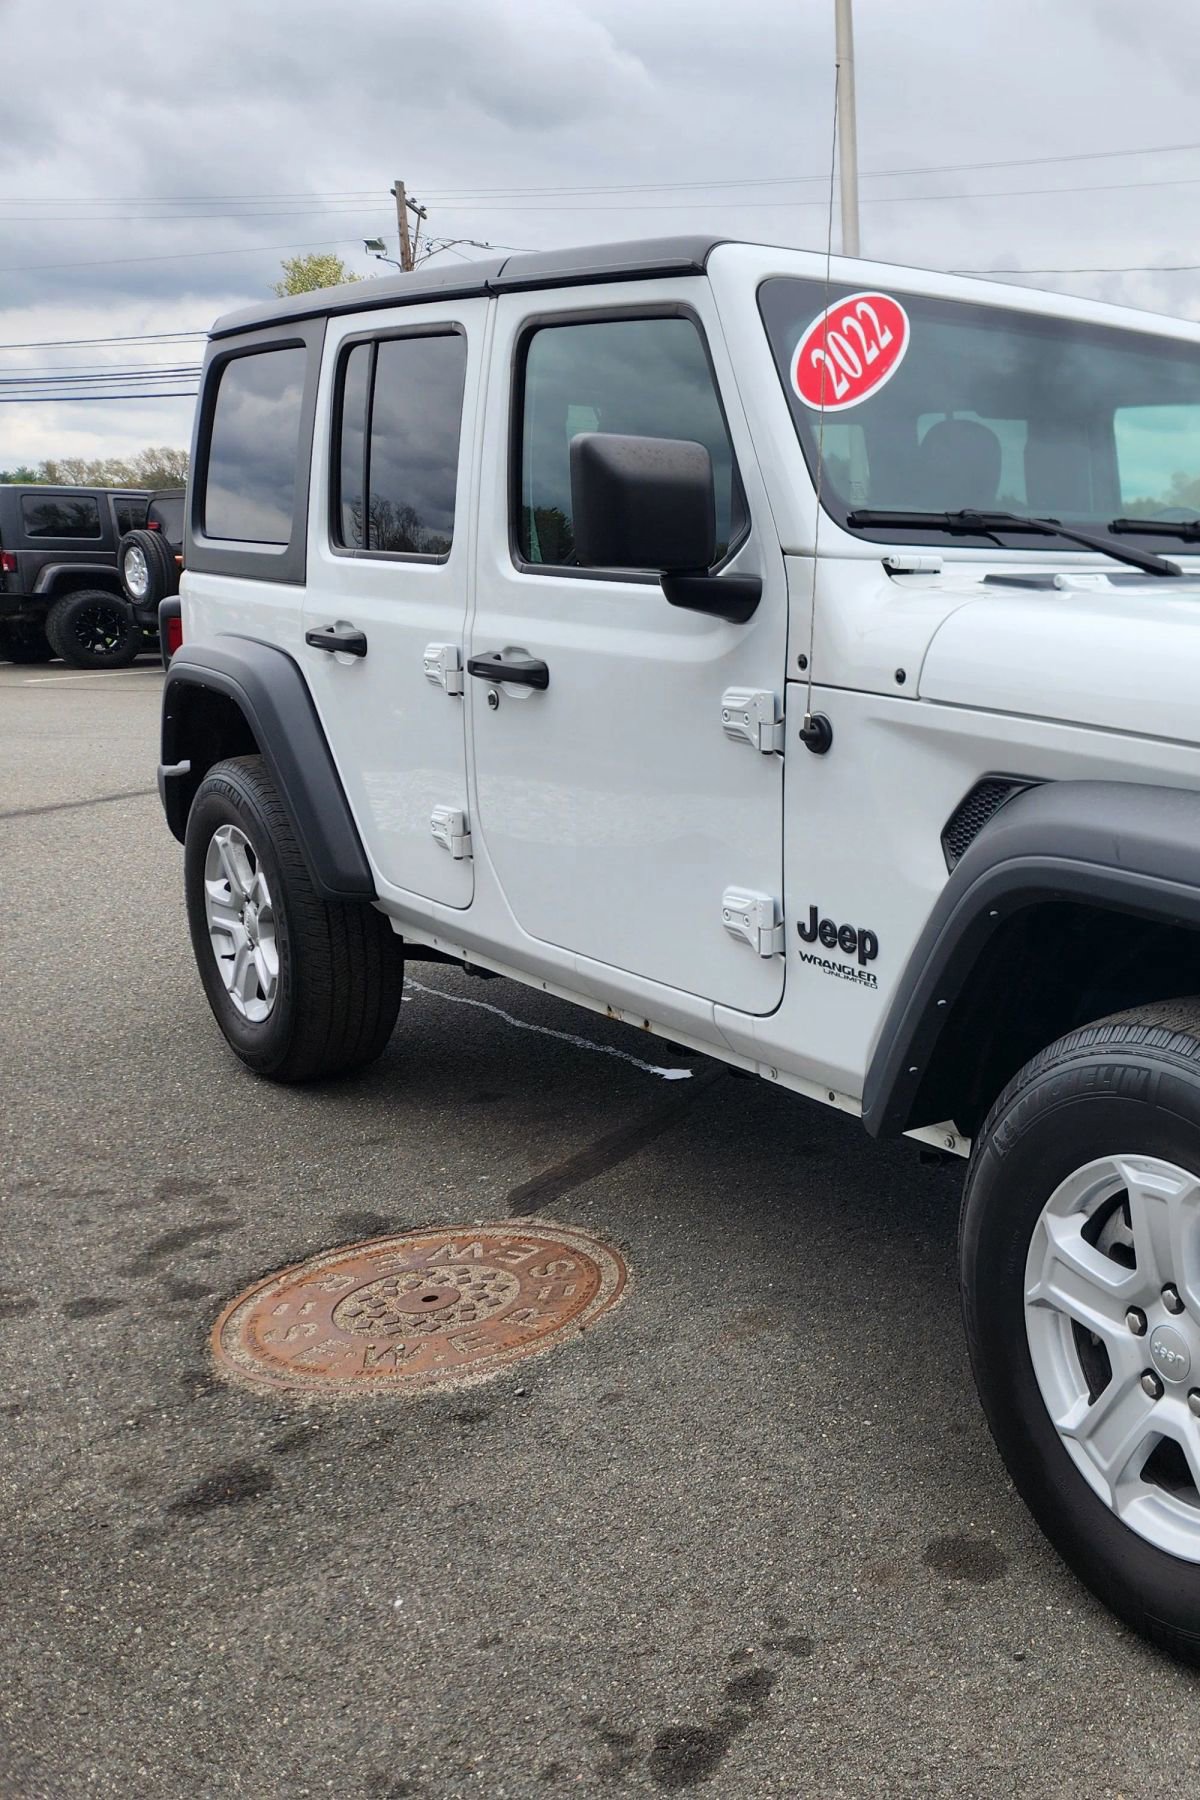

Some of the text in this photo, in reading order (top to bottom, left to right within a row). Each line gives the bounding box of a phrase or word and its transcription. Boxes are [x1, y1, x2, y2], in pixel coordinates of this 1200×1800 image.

[811, 301, 894, 400] 2022
[797, 904, 879, 966] Jeep
[798, 950, 877, 985] WRANGLER
[823, 968, 878, 990] UNLIMITED
